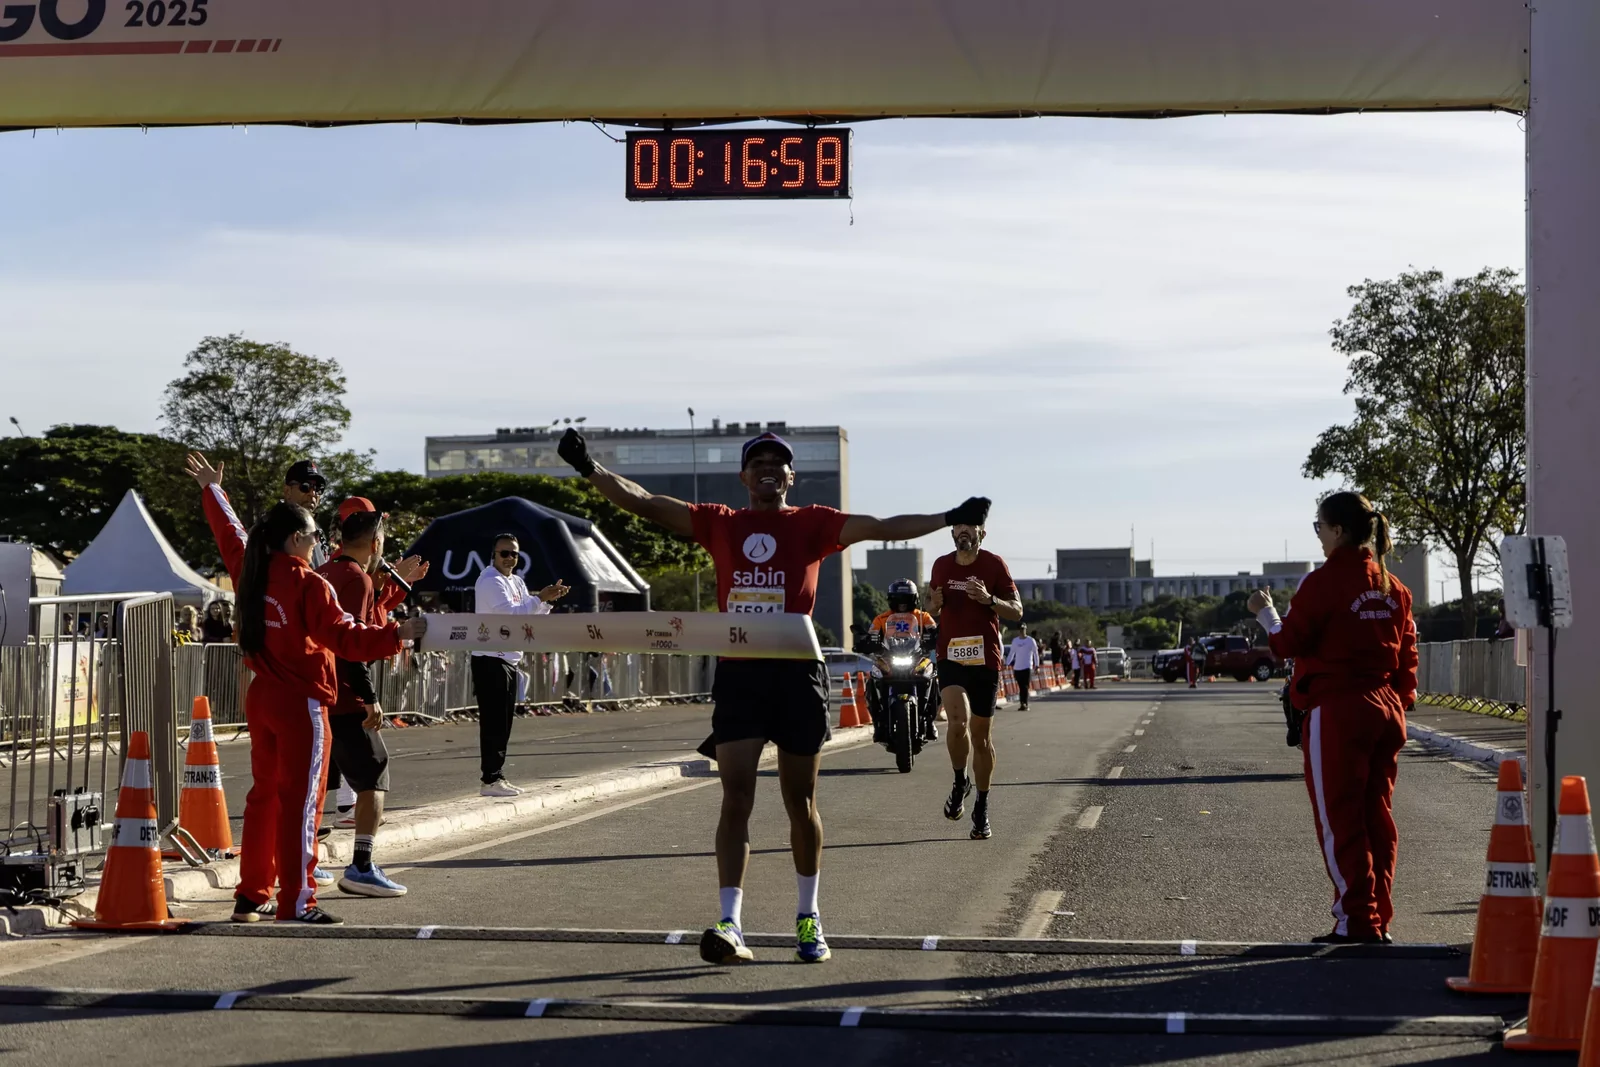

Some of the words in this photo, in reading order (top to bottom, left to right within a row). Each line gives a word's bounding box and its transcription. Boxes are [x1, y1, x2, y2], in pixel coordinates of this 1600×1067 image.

[124, 0, 208, 27] 2025
[634, 137, 842, 189] 00:16:58
[733, 566, 786, 586] sabin
[586, 624, 604, 640] 5k
[729, 627, 748, 643] 5k
[953, 647, 979, 658] 5886
